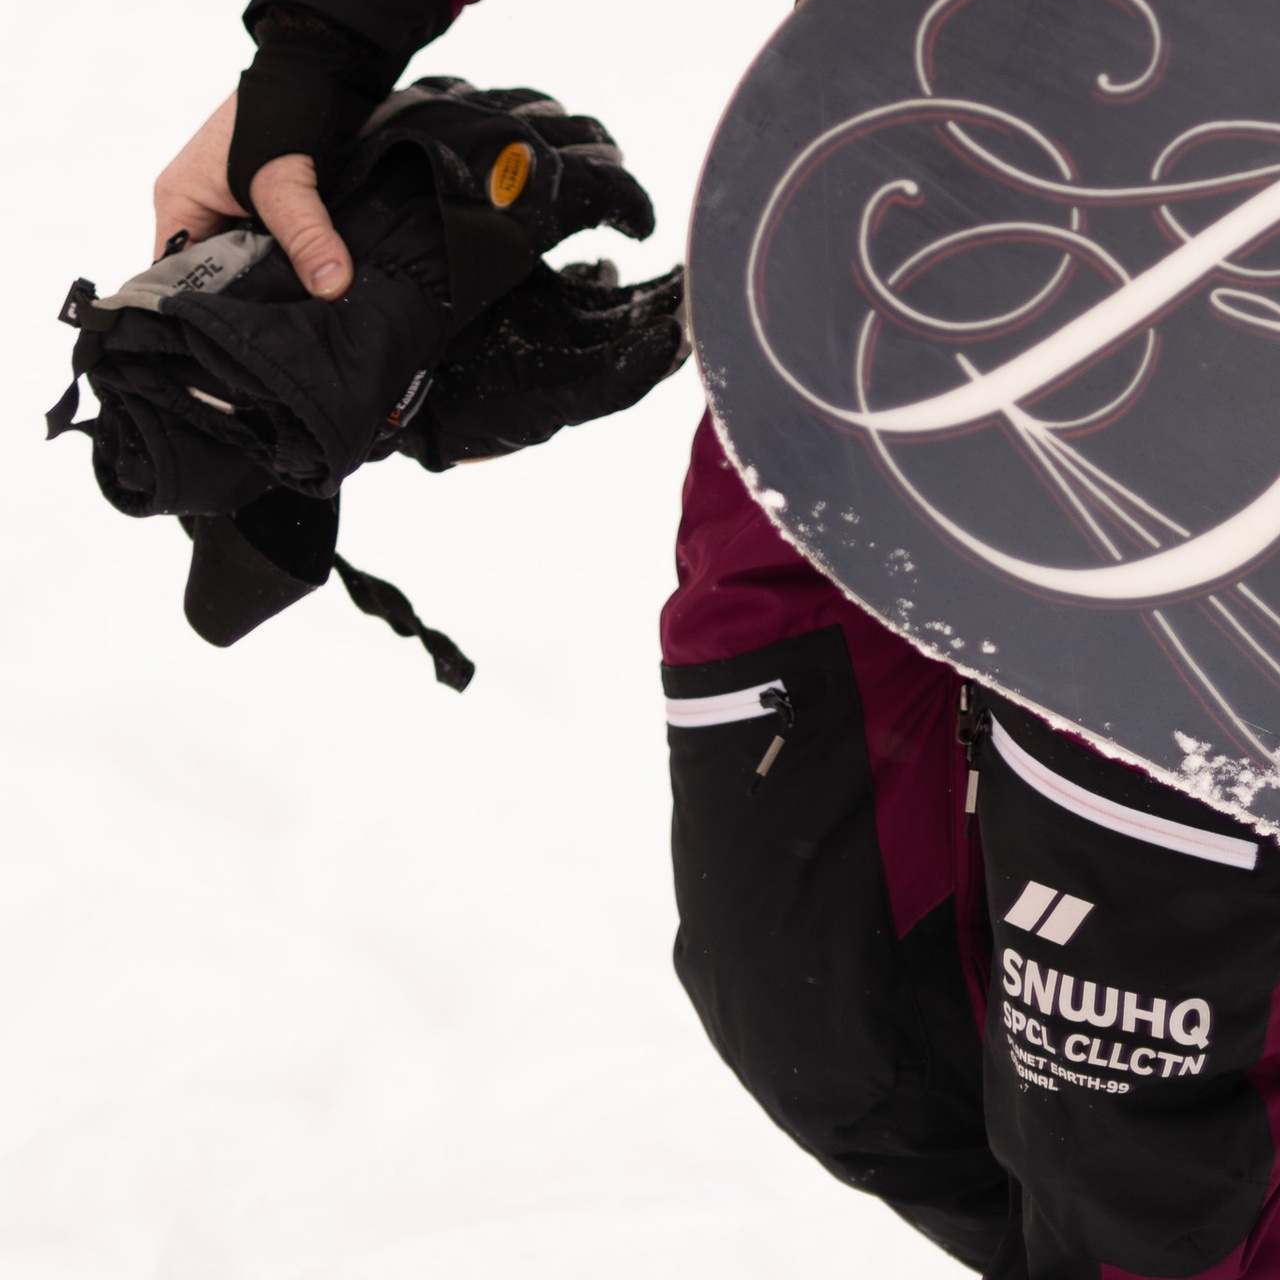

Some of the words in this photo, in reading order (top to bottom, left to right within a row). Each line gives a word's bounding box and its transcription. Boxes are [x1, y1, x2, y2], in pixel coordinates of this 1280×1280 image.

[1002, 947, 1211, 1049] SNWHQ
[1003, 1000, 1057, 1055] SPCL
[1064, 1033, 1206, 1078] CLLCTN
[1050, 1061, 1130, 1094] EARTH-99
